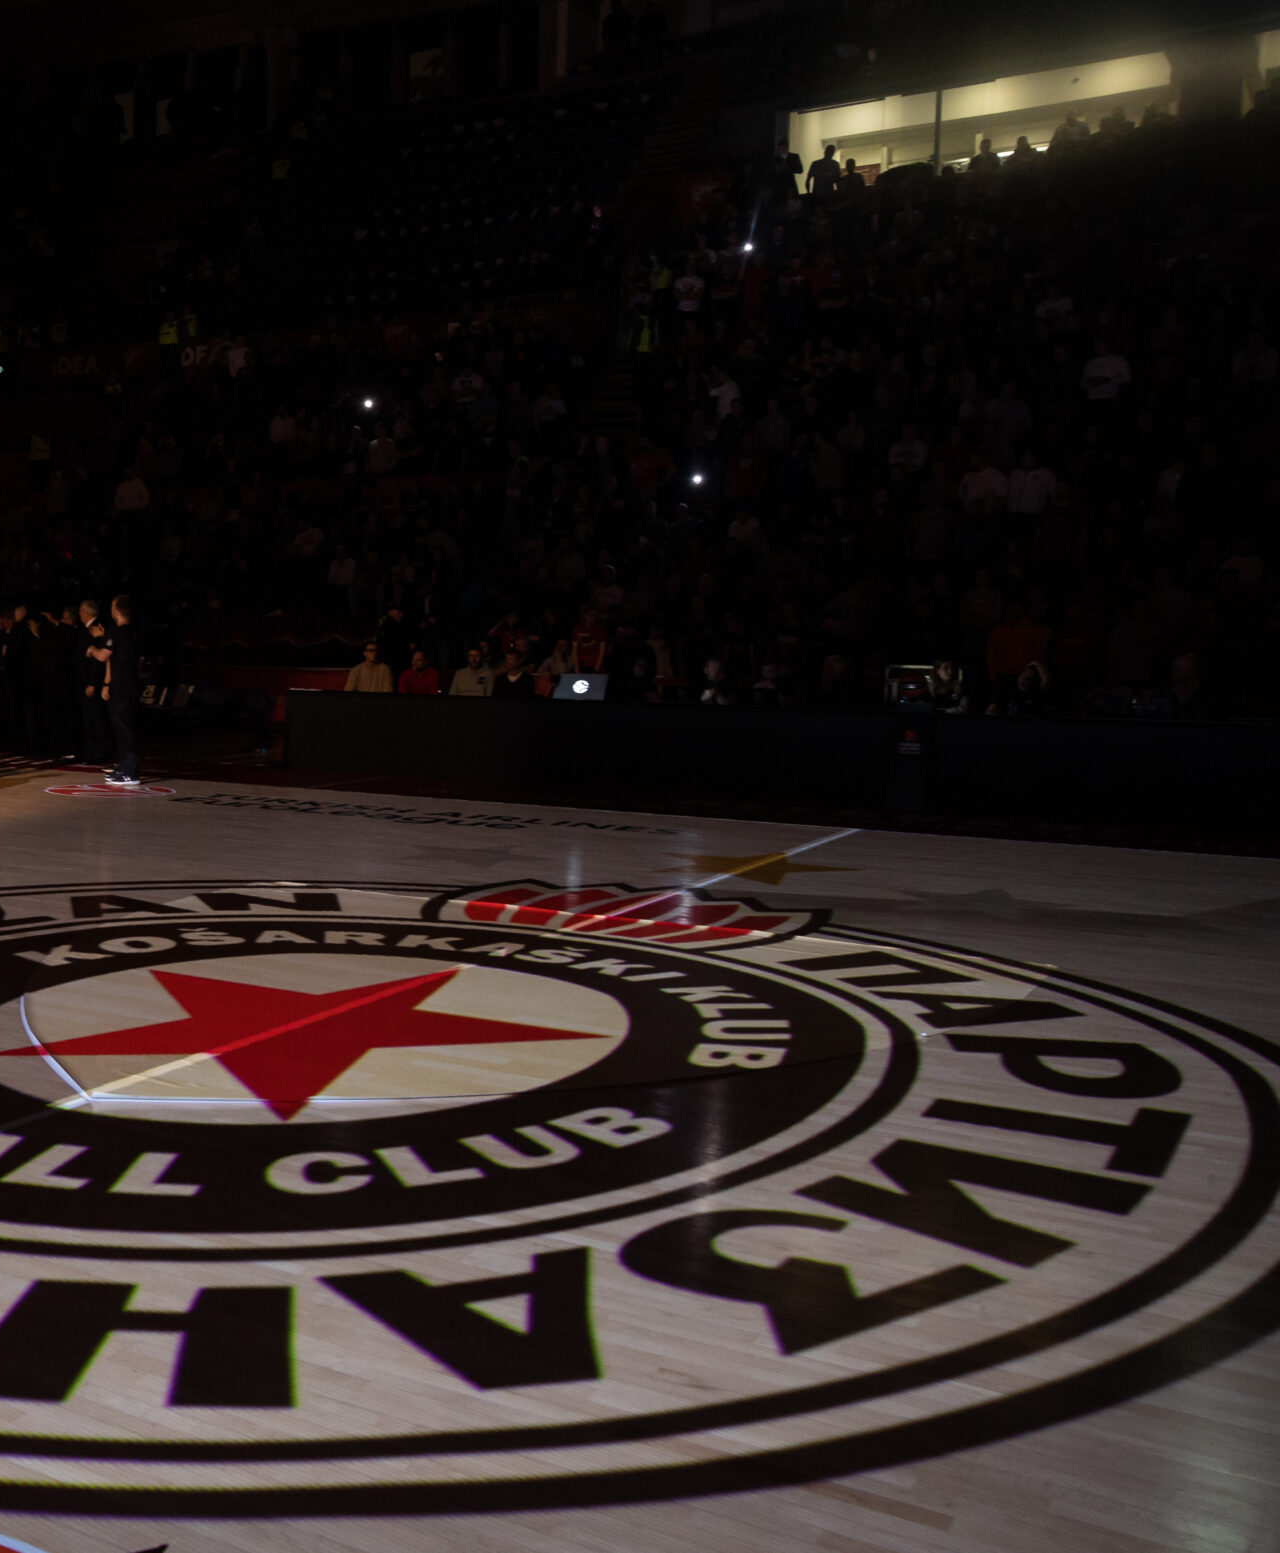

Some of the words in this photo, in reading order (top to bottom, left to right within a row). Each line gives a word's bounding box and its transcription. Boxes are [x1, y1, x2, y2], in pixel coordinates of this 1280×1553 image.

[170, 796, 527, 830] EuroLeague
[208, 793, 417, 814] TURKISH
[428, 810, 680, 835] AIRLINES
[12, 927, 688, 982] KOŠARKAŠKI
[658, 985, 793, 1070] KLUB
[264, 1106, 675, 1195] CLUB
